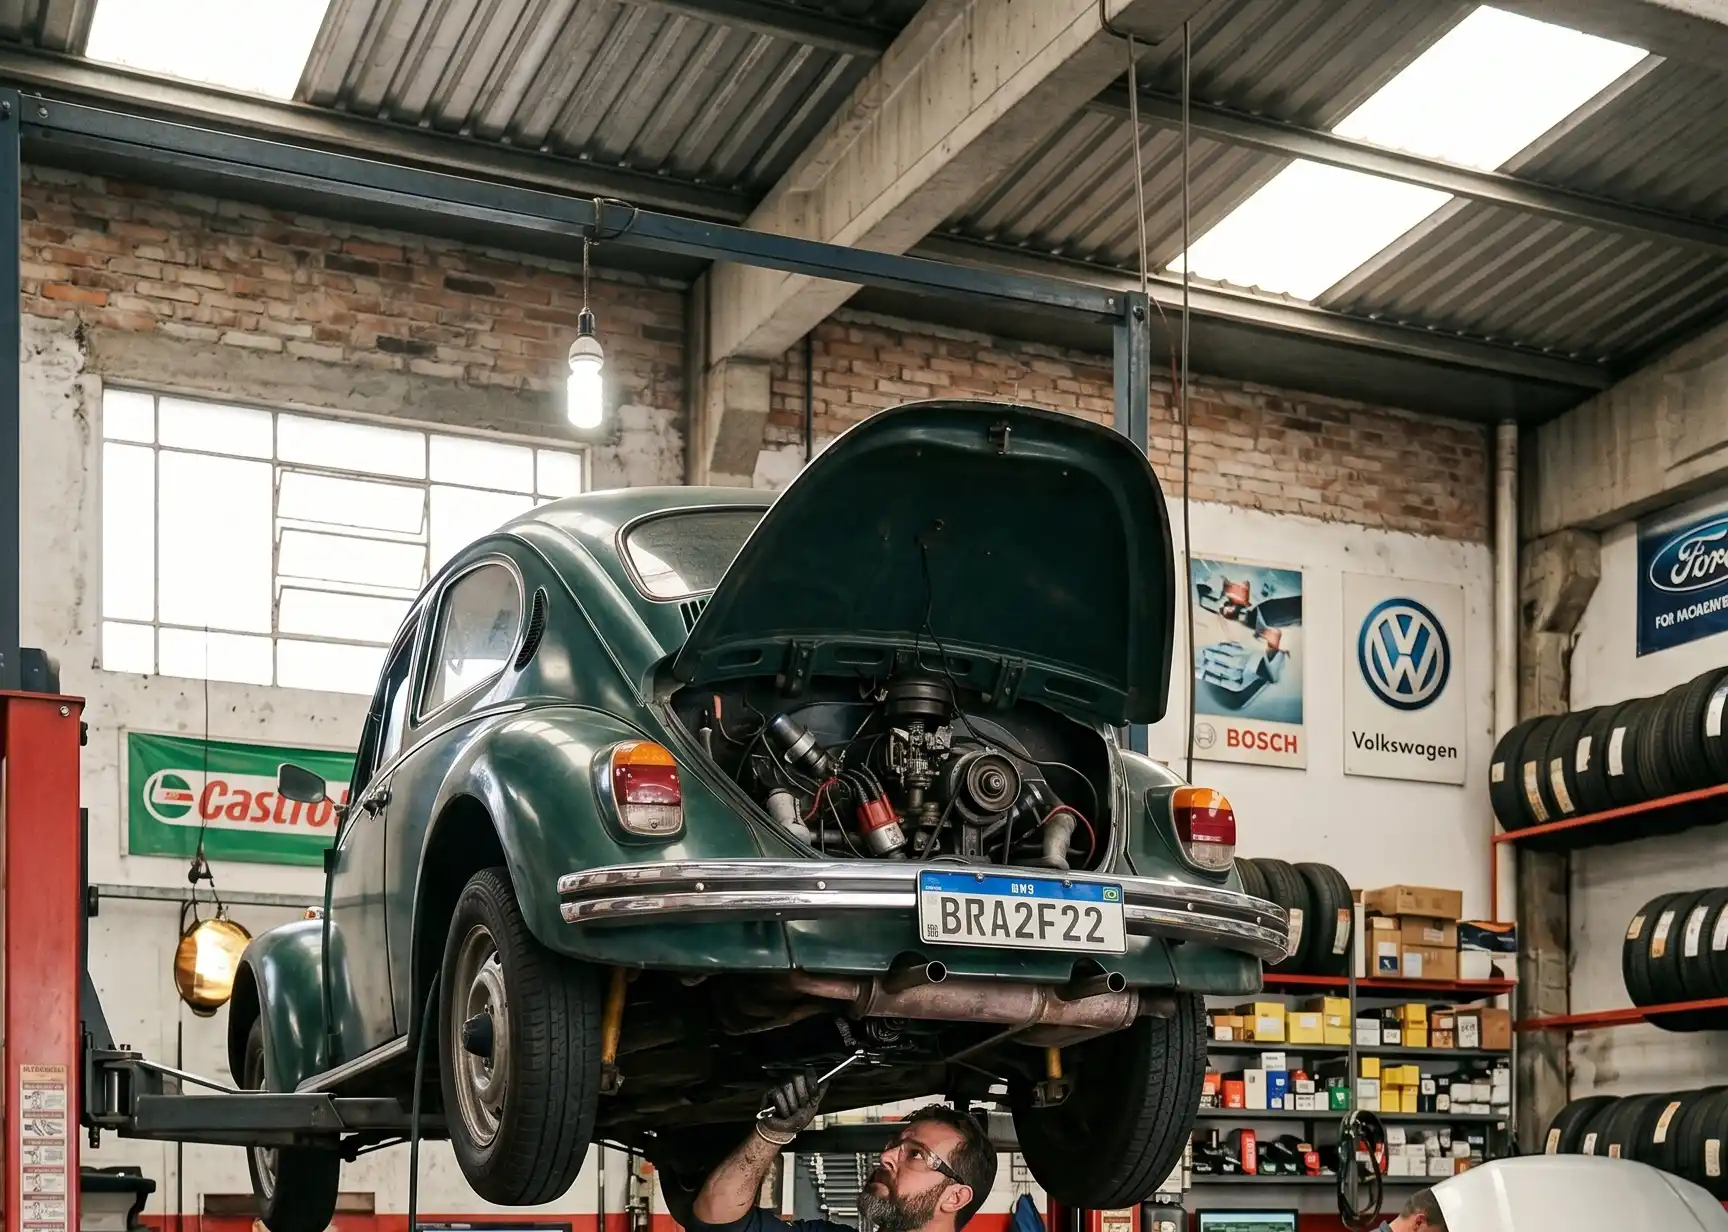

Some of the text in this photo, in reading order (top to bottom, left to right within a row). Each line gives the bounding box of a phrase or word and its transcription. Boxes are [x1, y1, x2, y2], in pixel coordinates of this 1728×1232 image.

[1655, 612, 1675, 629] FOR
[1226, 728, 1297, 754] BOSCH
[1352, 731, 1458, 761] Volkswagen
[940, 896, 1105, 944] BRA2F22
